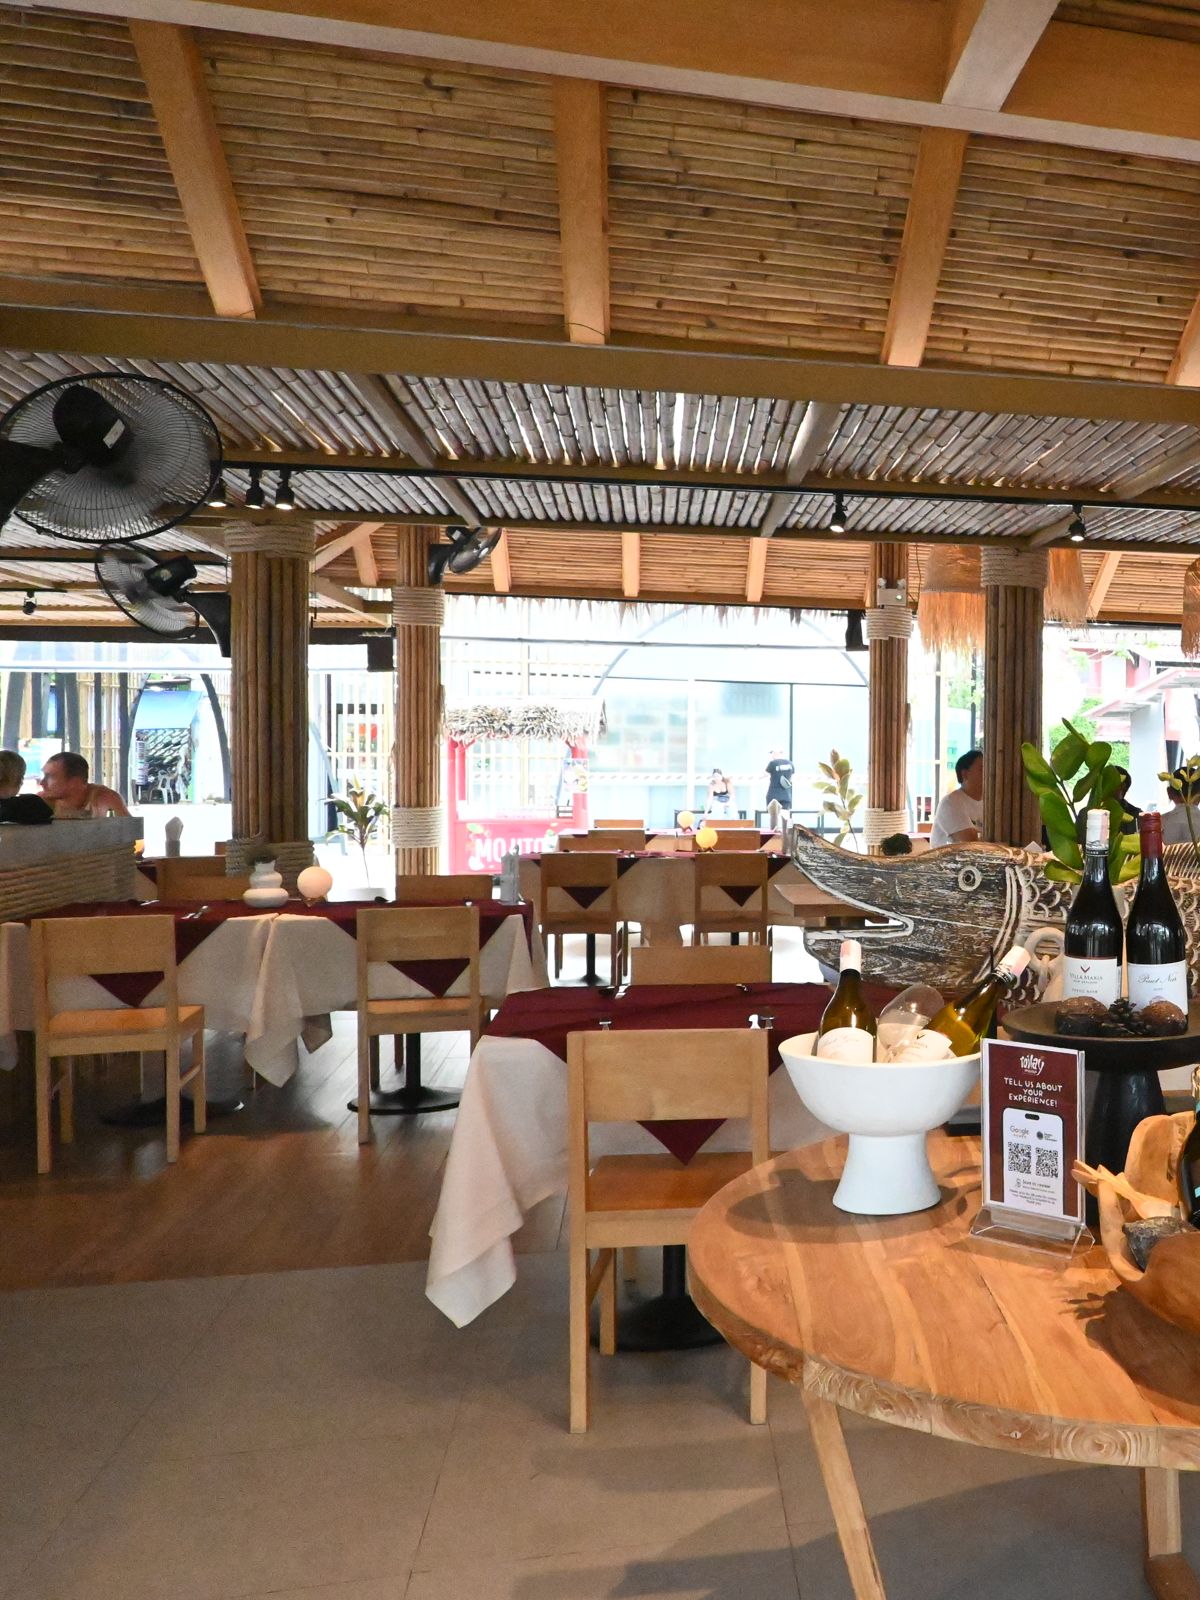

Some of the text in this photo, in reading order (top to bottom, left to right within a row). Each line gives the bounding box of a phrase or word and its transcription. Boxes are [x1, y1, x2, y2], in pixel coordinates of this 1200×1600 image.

[1004, 1077, 1063, 1092] TELL US ABOUT
[1023, 1088, 1044, 1097] YOUR
[1008, 1092, 1058, 1107] EXPERIENCE!
[1009, 1125, 1030, 1136] Google
